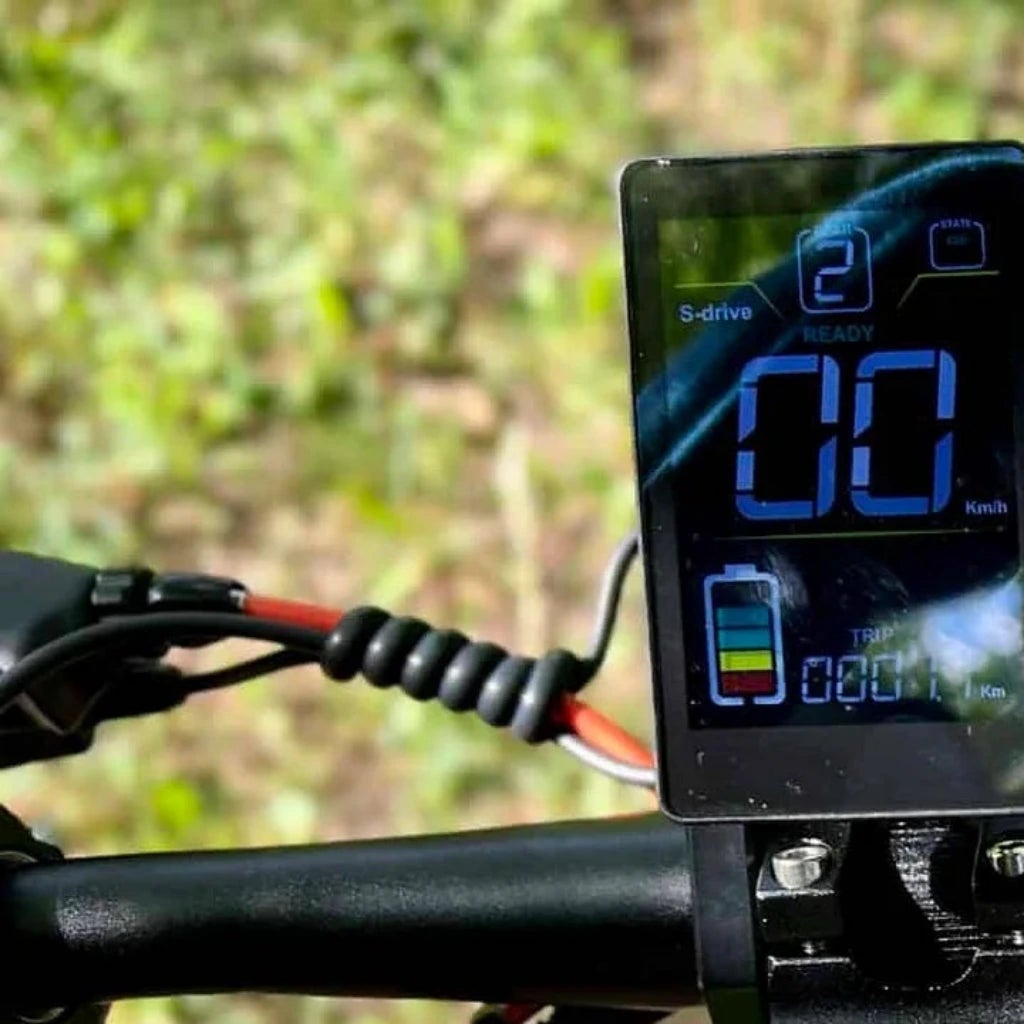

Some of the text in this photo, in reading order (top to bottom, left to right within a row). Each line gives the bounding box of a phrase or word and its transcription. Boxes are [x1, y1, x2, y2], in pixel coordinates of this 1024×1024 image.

[813, 239, 854, 302] 2
[679, 302, 753, 324] S-drive
[802, 325, 875, 343] READY
[736, 349, 1008, 520] 00 Km/h
[849, 627, 894, 646] TRIP
[980, 683, 1006, 699] Km
